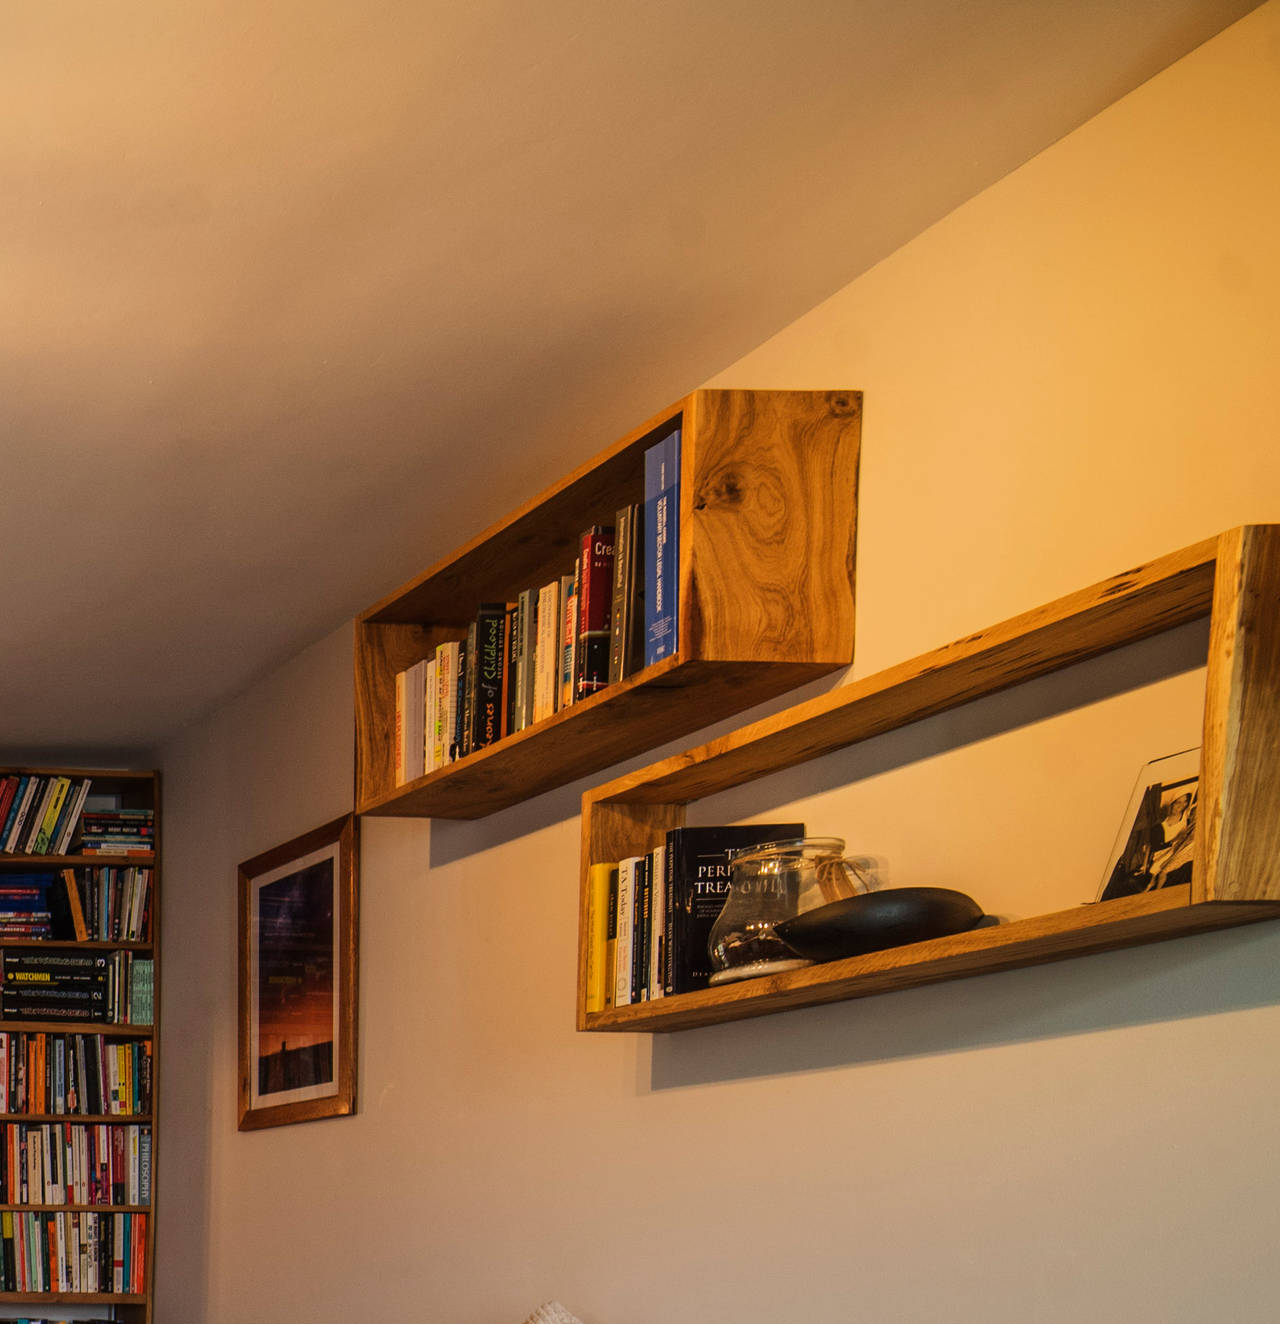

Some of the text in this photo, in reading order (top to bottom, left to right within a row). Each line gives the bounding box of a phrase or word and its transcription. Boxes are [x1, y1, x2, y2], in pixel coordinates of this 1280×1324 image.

[482, 619, 499, 679] Childhood
[481, 682, 498, 698] of
[619, 885, 628, 916] Today
[15, 972, 51, 982] WATCHMEN
[141, 1143, 150, 1199] PHILOSOPHY
